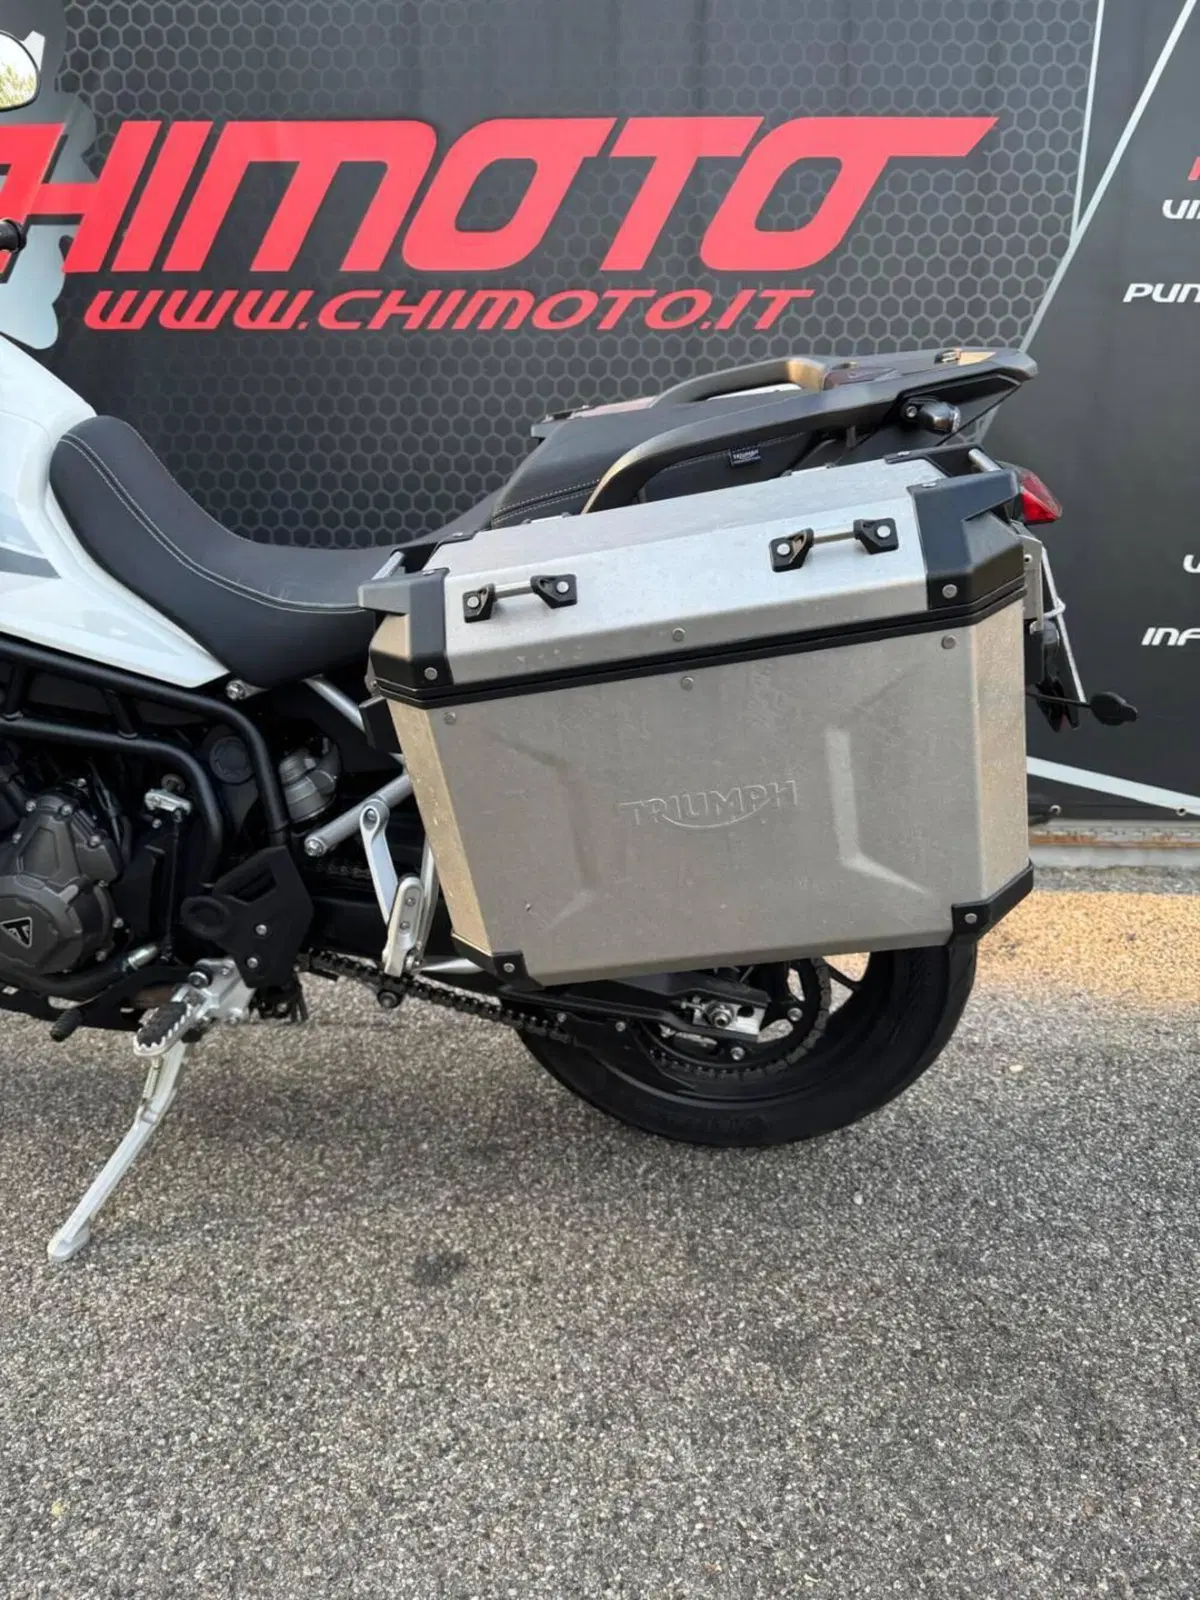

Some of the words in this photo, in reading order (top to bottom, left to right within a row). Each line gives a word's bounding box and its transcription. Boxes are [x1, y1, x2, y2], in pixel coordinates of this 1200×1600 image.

[0, 116, 997, 274] HIMOTO
[84, 288, 815, 331] WWW.CHIMOTO.IT
[1123, 283, 1200, 303] PUN
[619, 780, 799, 828] TRIUMPH
